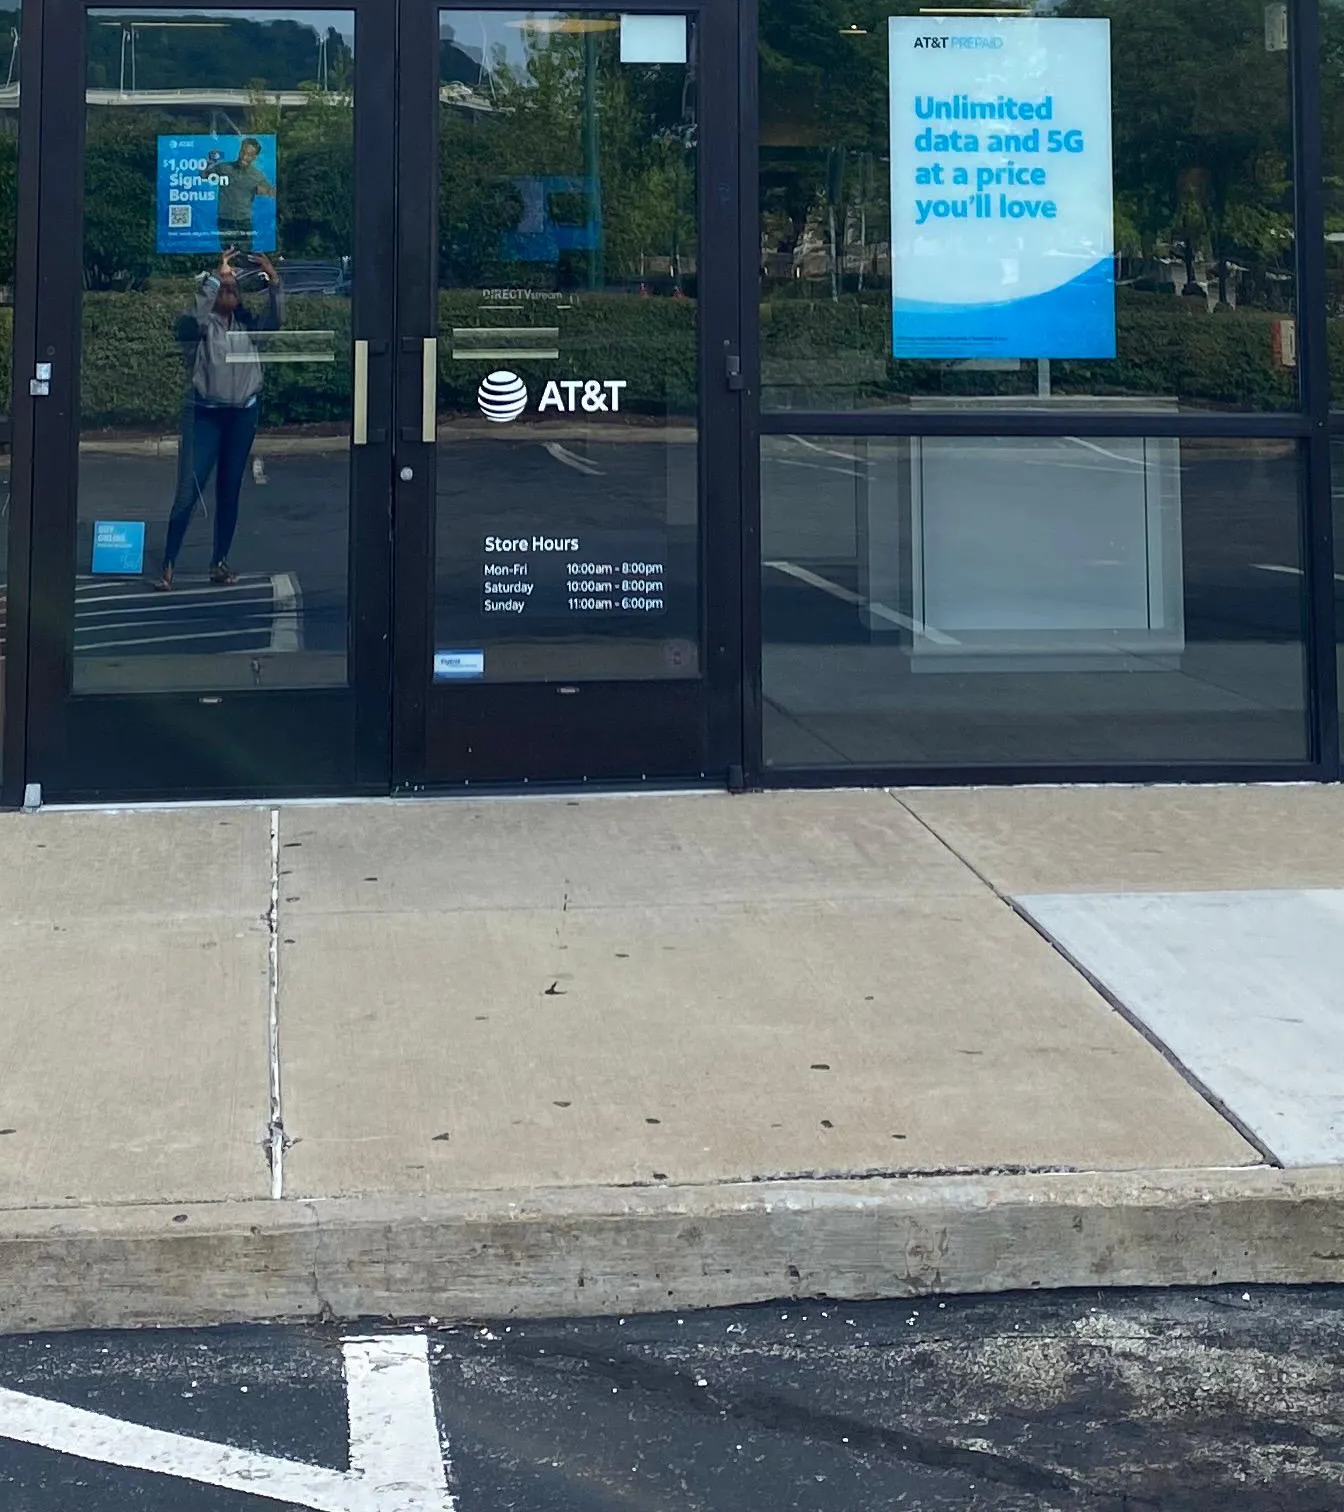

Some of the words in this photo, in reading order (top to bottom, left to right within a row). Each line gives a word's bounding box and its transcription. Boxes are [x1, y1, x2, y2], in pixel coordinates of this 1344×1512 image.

[913, 36, 949, 49] AT&T
[951, 36, 1004, 49] PREPAID
[914, 95, 1053, 121] Unlimited
[914, 128, 979, 153] data
[987, 128, 1039, 153] and
[1047, 129, 1084, 153] 5G
[163, 158, 207, 174] $1,000
[169, 173, 229, 189] Sign-On
[915, 162, 945, 185] at
[952, 167, 968, 185] a
[976, 160, 1046, 191] price
[169, 189, 216, 202] Bonus
[915, 194, 991, 224] you'll
[999, 195, 1057, 220] love
[538, 380, 627, 412] AT&T
[485, 536, 529, 552] Store
[532, 536, 579, 552] Hours
[484, 562, 528, 576] Mon-Fri
[566, 562, 613, 575] 10:00am
[621, 562, 663, 576] 8:00pm
[484, 580, 534, 595] Saturday
[566, 580, 613, 592] 10:00am
[621, 579, 663, 593] 8:00pm
[484, 598, 525, 613] Sunday
[568, 597, 613, 610] 11:00am
[621, 597, 663, 611] 6:00pm
